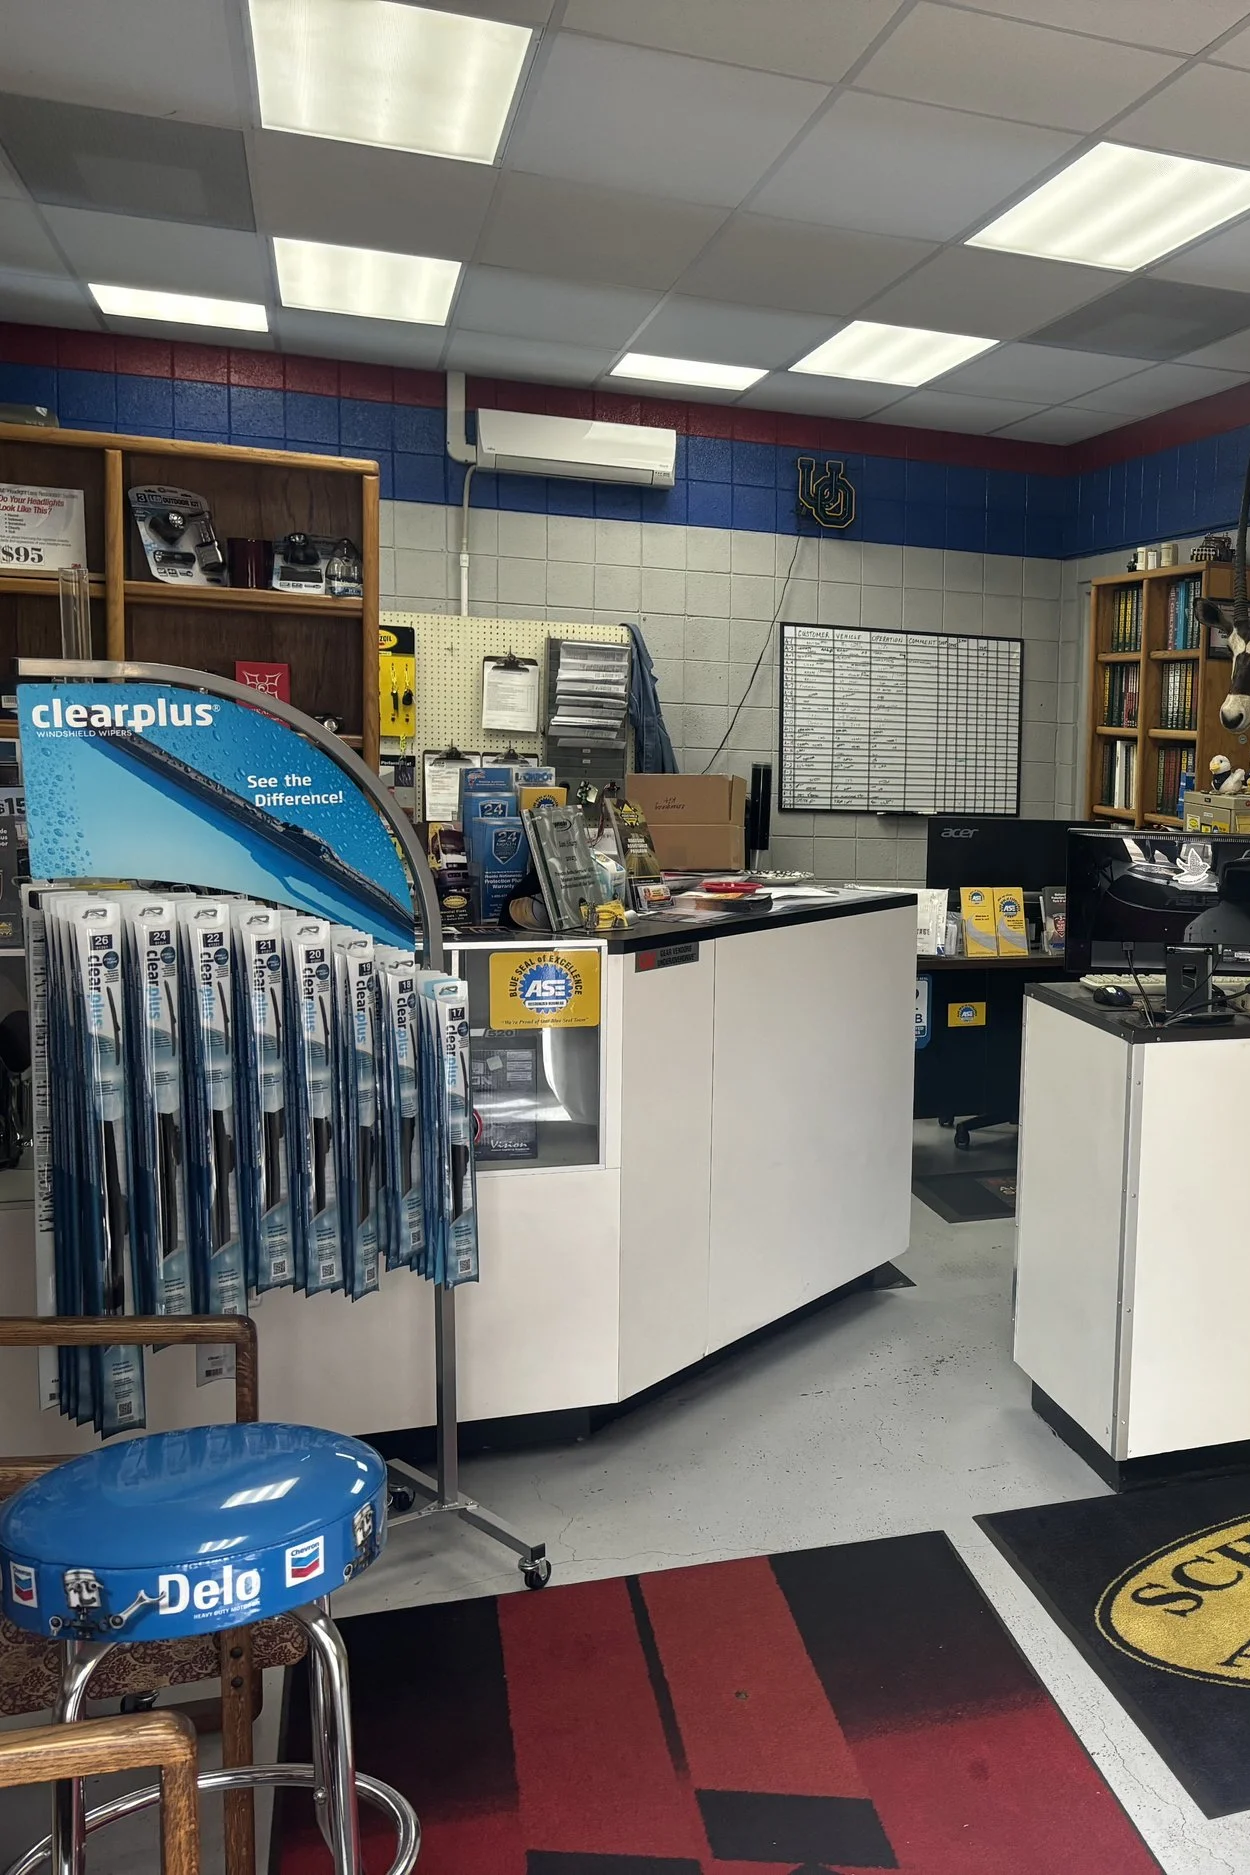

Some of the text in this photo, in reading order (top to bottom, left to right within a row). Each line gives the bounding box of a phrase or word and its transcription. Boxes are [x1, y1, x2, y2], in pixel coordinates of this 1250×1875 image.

[10, 496, 26, 504] Your
[27, 497, 65, 507] Headlights
[0, 504, 52, 515] Look Like This?
[1, 544, 44, 564] $95
[36, 729, 132, 738] WINDSHIELD WIPERS
[247, 774, 312, 788] See the
[255, 791, 344, 807] Difference!
[484, 804, 504, 815] 24
[497, 832, 518, 843] 24
[941, 827, 979, 839] acer
[95, 936, 109, 945] 26
[154, 931, 166, 940] 24
[207, 934, 220, 943] 22
[260, 941, 272, 950] 21
[309, 950, 321, 959] 20
[362, 963, 371, 971] 19
[509, 954, 583, 998] BLUE SEAL of EXCELLENCE
[402, 981, 411, 989] 18
[525, 979, 566, 997] ASE
[453, 1008, 462, 1017] 17
[488, 1029, 514, 1038] 520
[491, 1139, 527, 1149] Vision
[291, 1543, 320, 1557] Chevron
[158, 1564, 262, 1616] Delo
[193, 1607, 230, 1620] HEAVY DUTY
